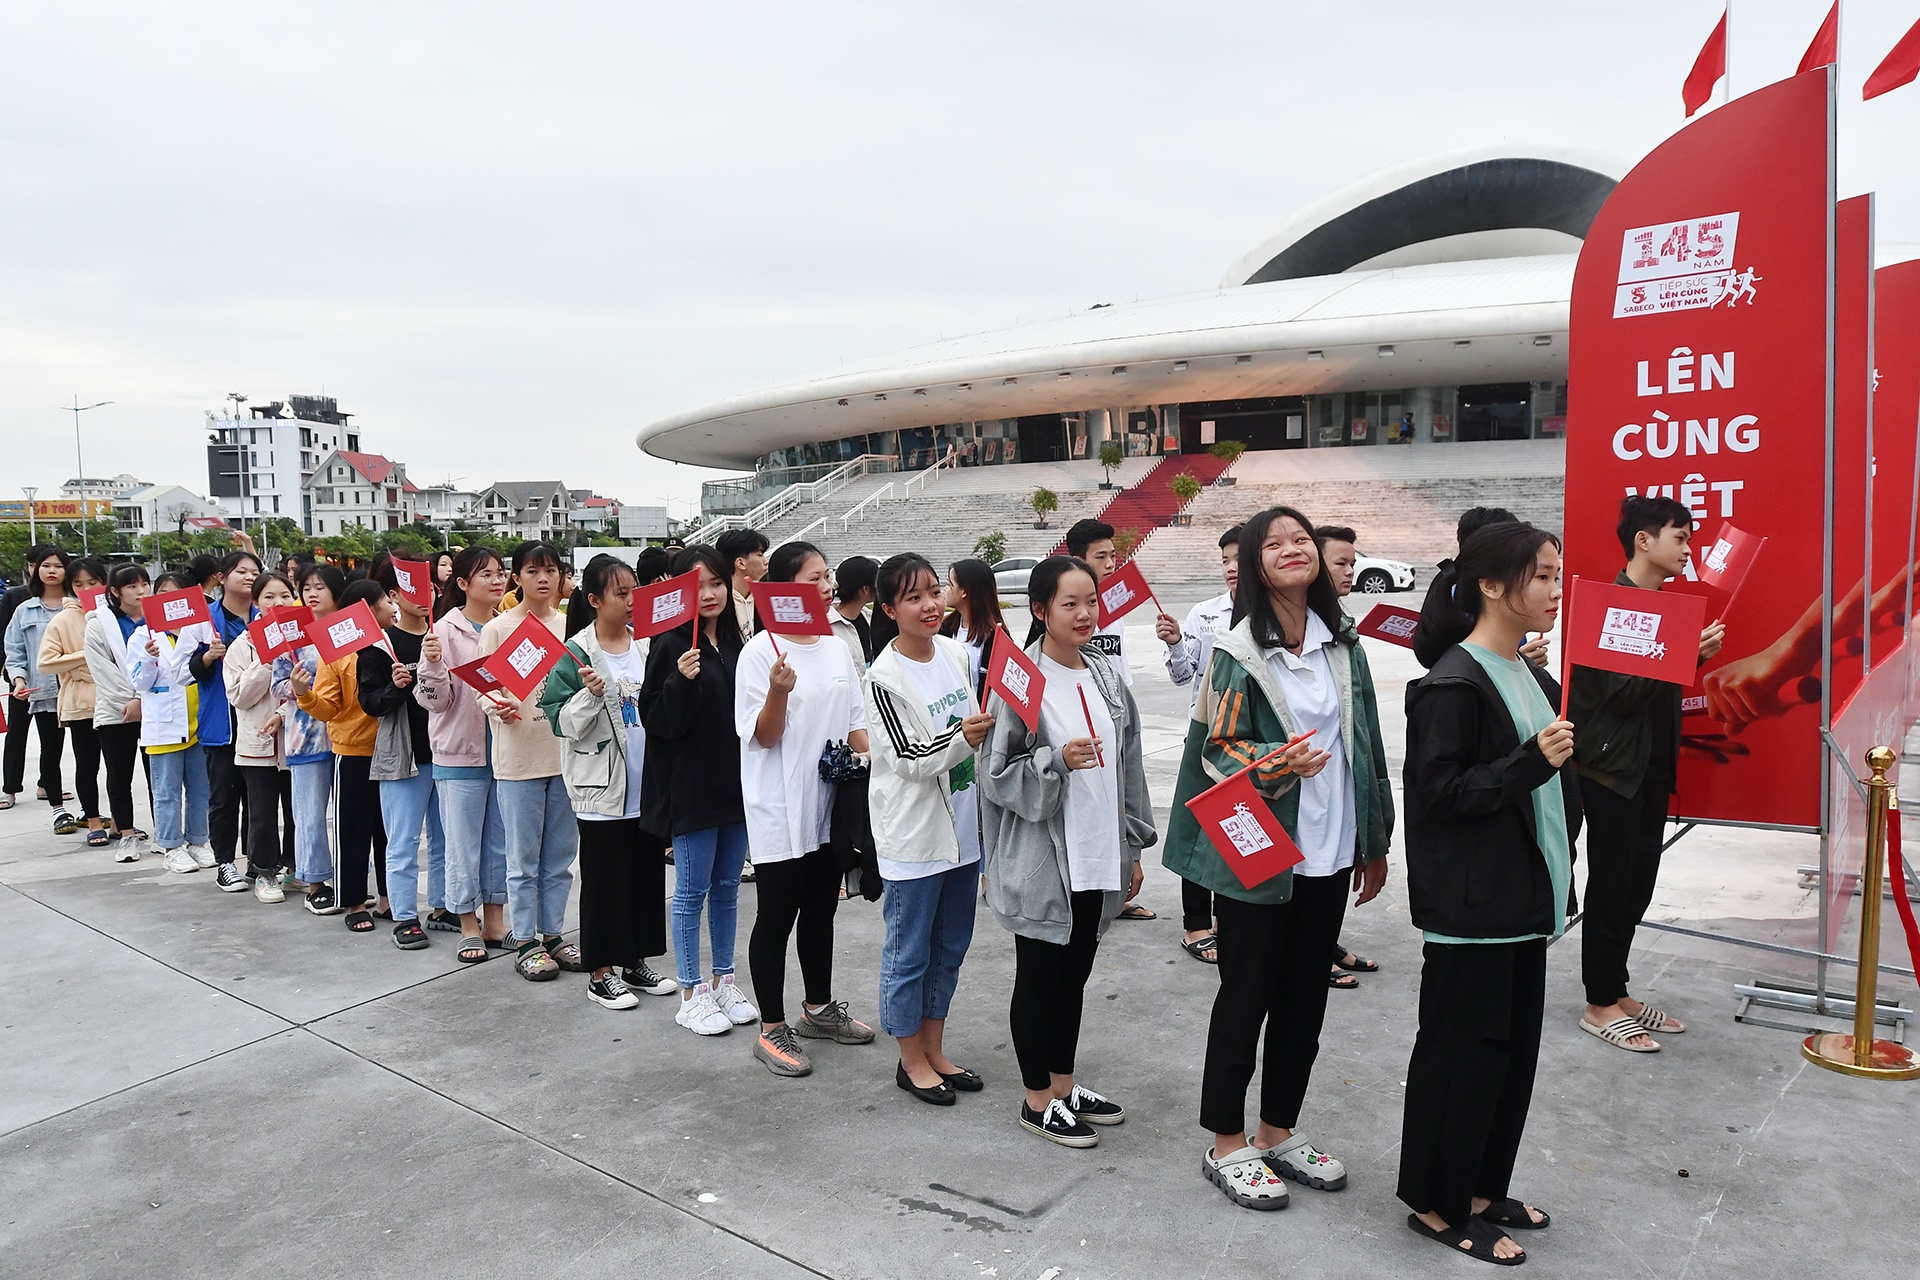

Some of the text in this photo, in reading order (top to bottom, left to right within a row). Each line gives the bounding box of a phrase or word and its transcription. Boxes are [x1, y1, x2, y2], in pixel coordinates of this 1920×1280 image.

[1633, 220, 1724, 269] 145
[1659, 286, 1708, 300] LÊN CÙNG
[1660, 296, 1708, 309] VIỆT NAM
[1623, 303, 1655, 314] SABECO
[1637, 346, 1735, 397] LÊN
[1612, 409, 1760, 461] CÙNG
[165, 600, 186, 611] 145
[656, 592, 678, 609] 145
[330, 620, 353, 637] 145
[1610, 611, 1654, 634] 145
[510, 642, 532, 666] 145
[1008, 661, 1027, 686] 145
